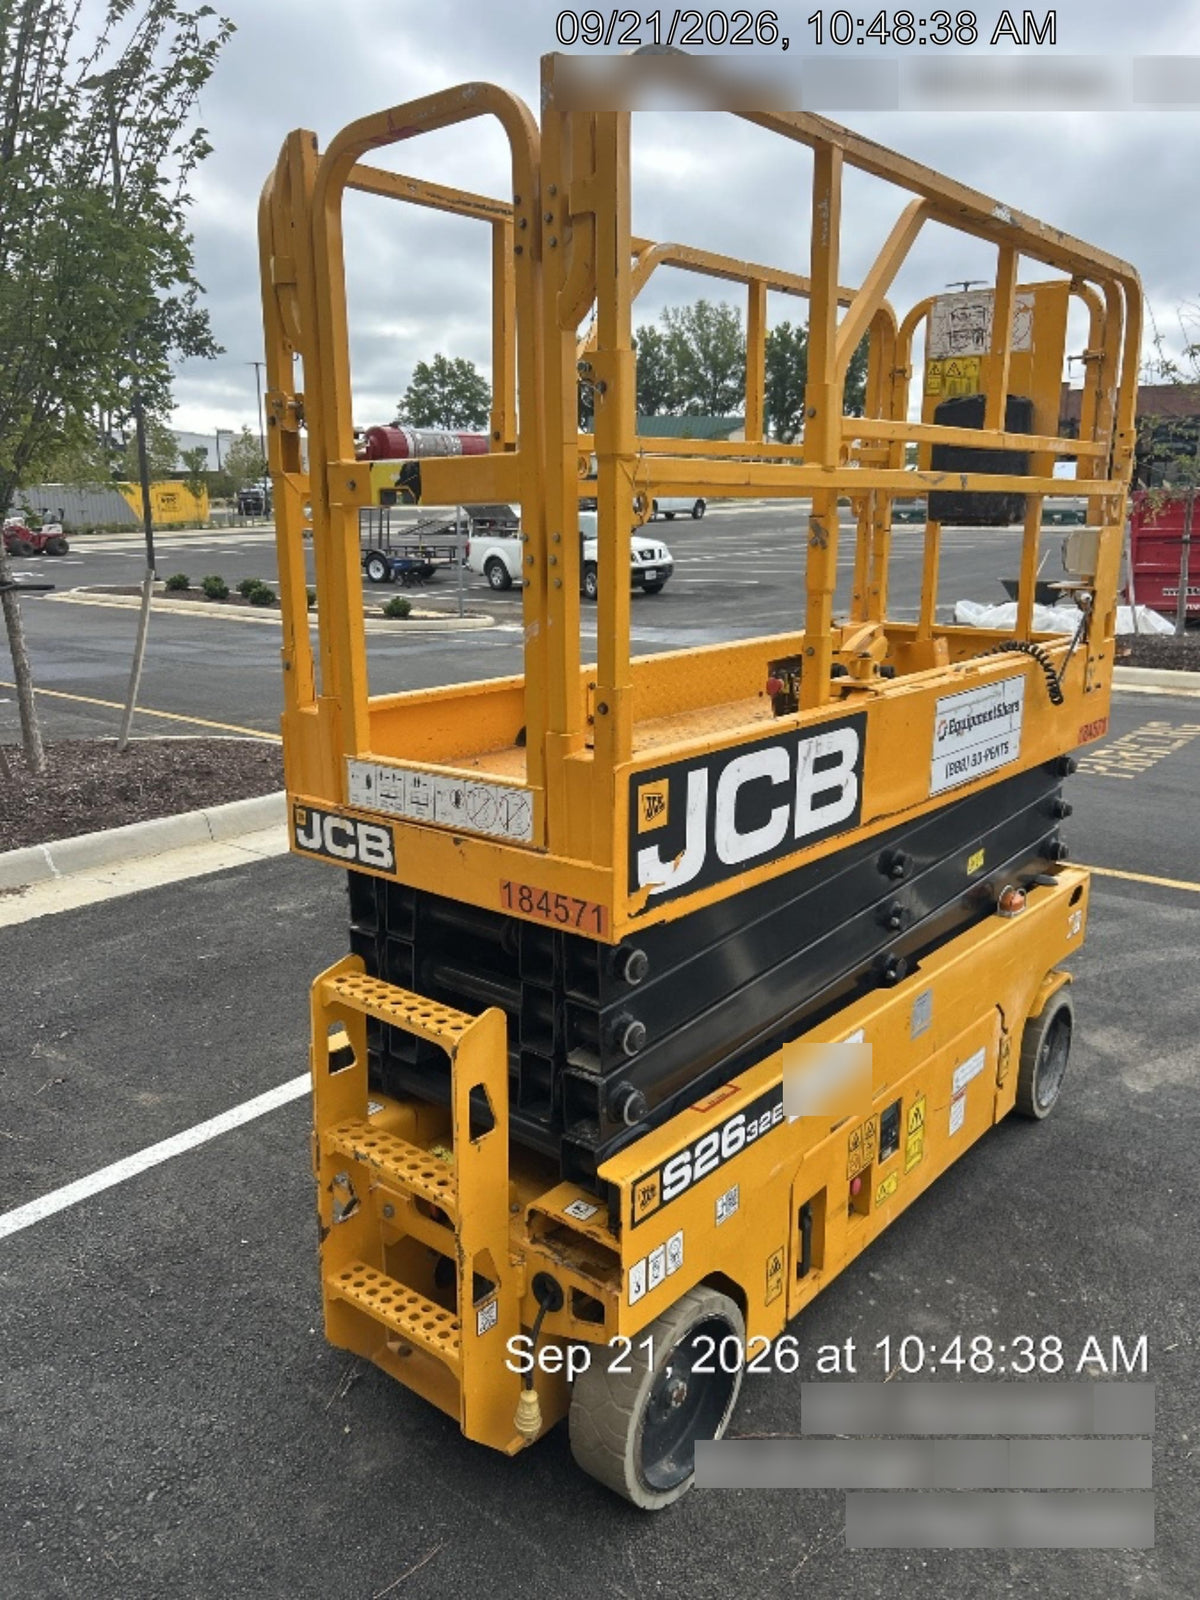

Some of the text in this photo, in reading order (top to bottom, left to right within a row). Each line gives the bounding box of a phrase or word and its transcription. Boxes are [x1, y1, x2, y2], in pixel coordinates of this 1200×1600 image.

[296, 811, 394, 869] JCB
[637, 726, 860, 896] JCB
[503, 880, 603, 934] 184571
